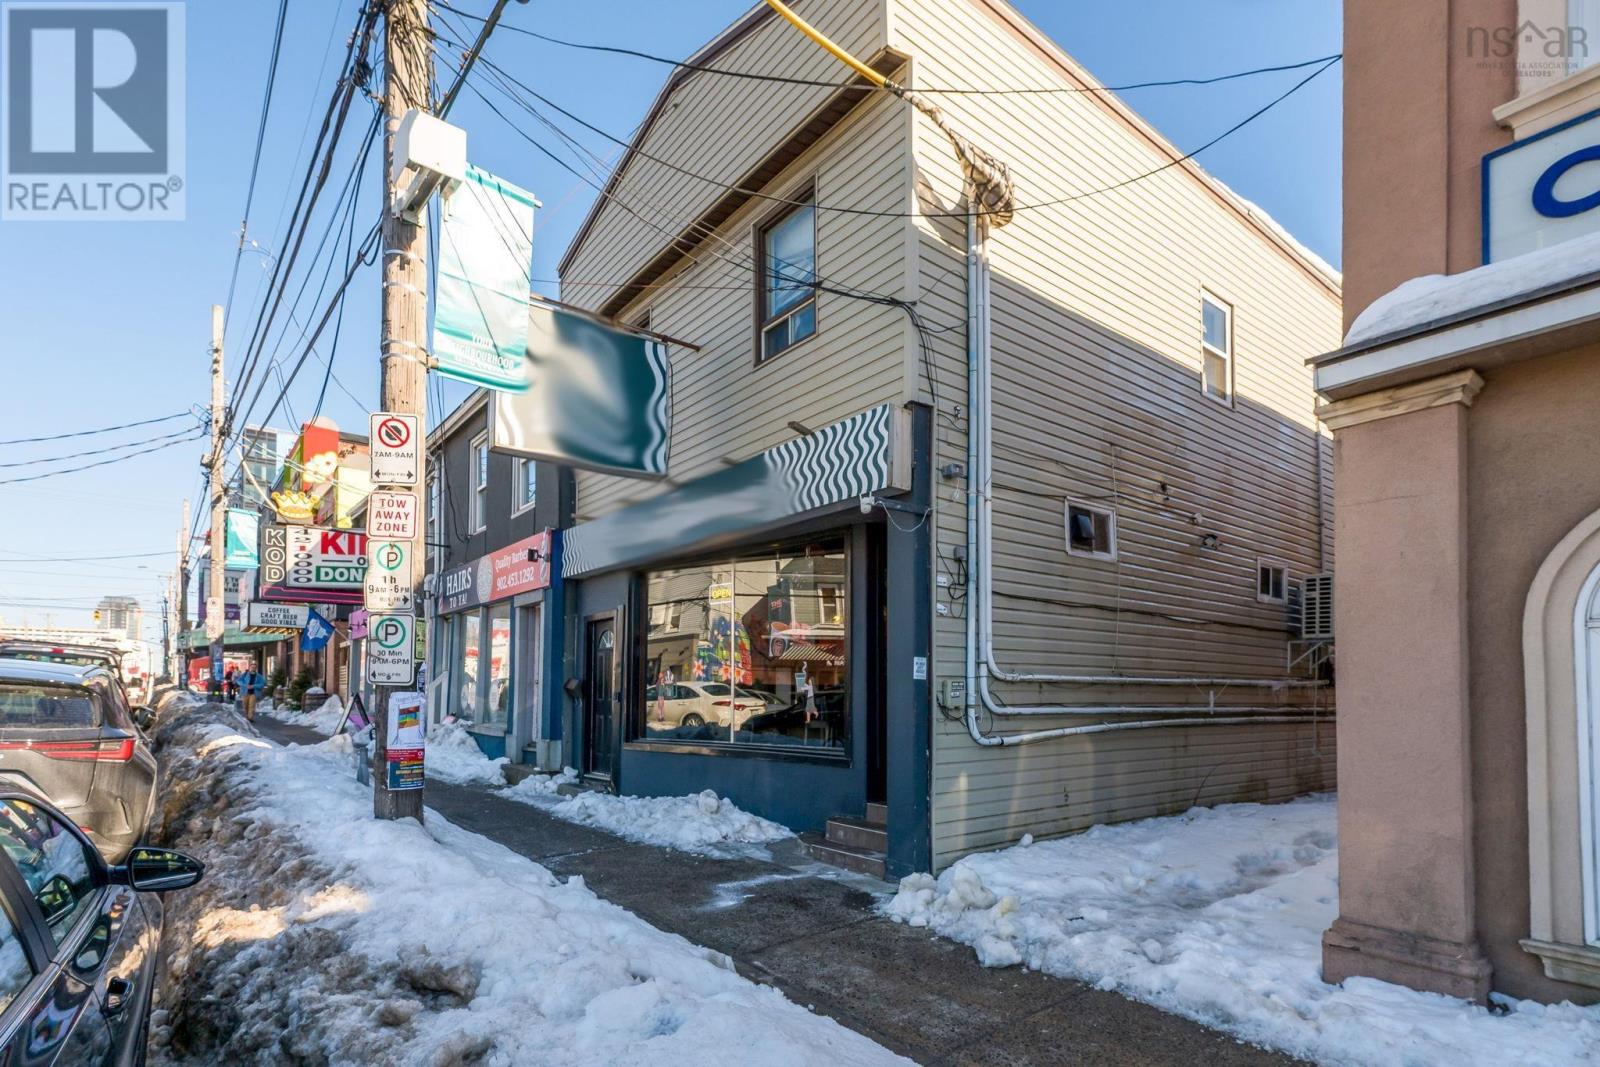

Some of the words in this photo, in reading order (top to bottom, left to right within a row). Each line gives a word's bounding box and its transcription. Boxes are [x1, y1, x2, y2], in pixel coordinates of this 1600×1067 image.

[451, 342, 514, 370] IGHBOURHOOD
[379, 498, 407, 508] TOW
[375, 510, 410, 520] AWAY
[376, 521, 408, 532] ZONE
[265, 528, 285, 582] KOD
[495, 556, 512, 573] Quality
[446, 567, 472, 596] HAIRS
[711, 588, 731, 599] OPEN
[450, 597, 457, 609] TO
